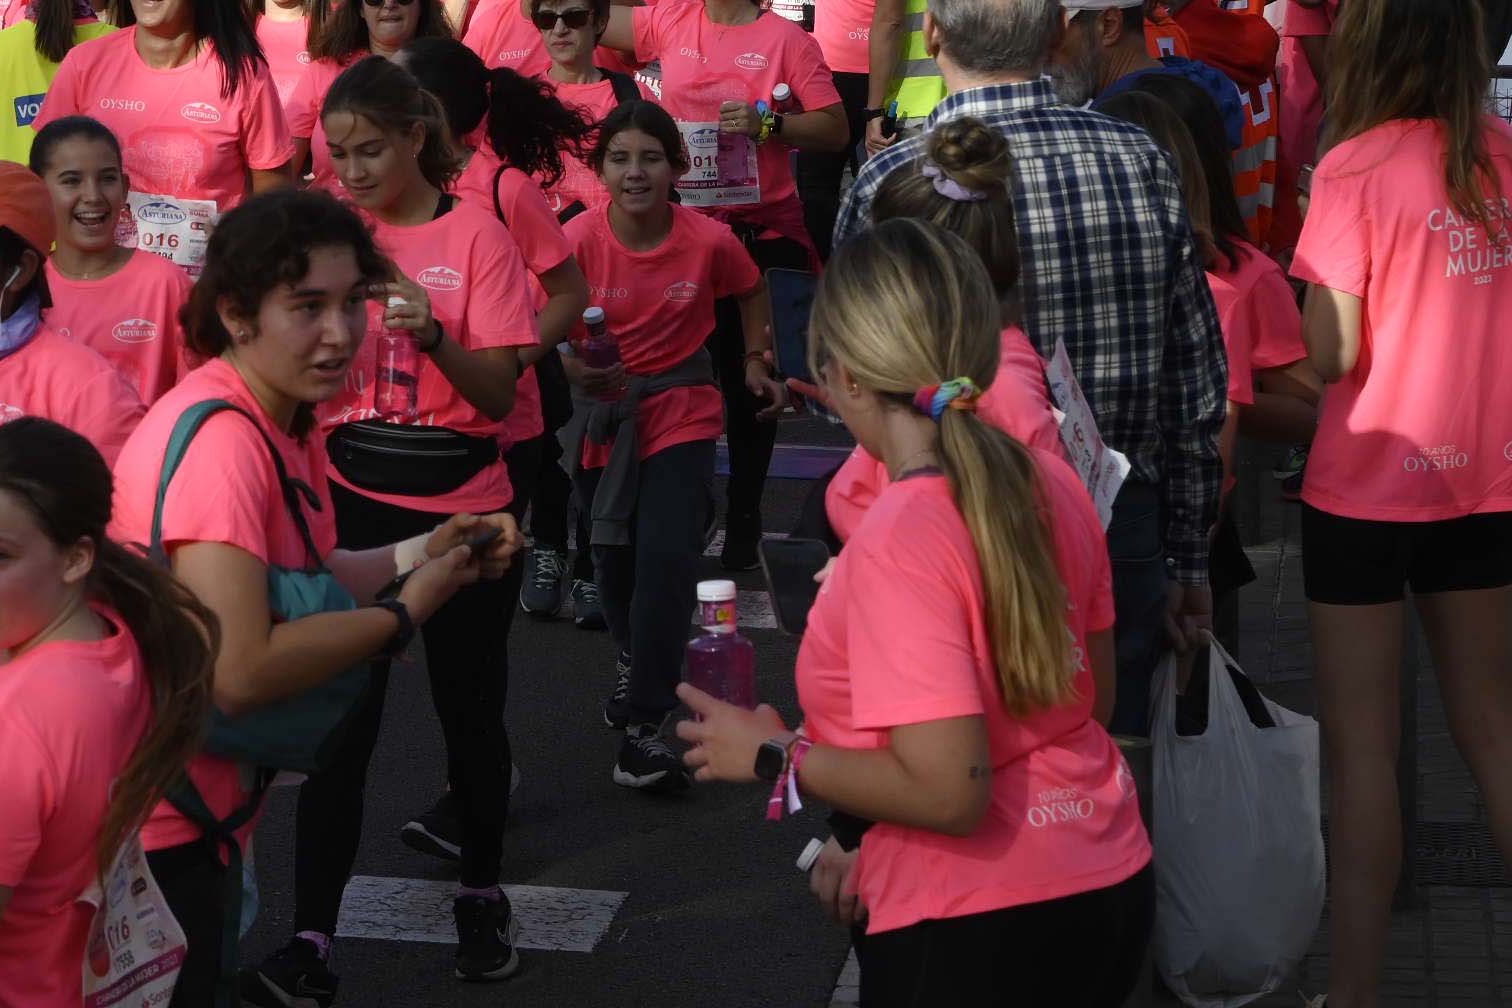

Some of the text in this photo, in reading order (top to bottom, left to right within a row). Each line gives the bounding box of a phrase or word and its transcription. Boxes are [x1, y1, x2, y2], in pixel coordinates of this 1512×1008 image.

[100, 98, 146, 113] OYSHO
[141, 209, 184, 222] ASTURIANA
[143, 232, 180, 248] 016
[1449, 227, 1478, 252] DE
[1446, 245, 1512, 278] MUJER
[1403, 452, 1468, 473] OYSHO
[1028, 798, 1094, 828] OYSHO
